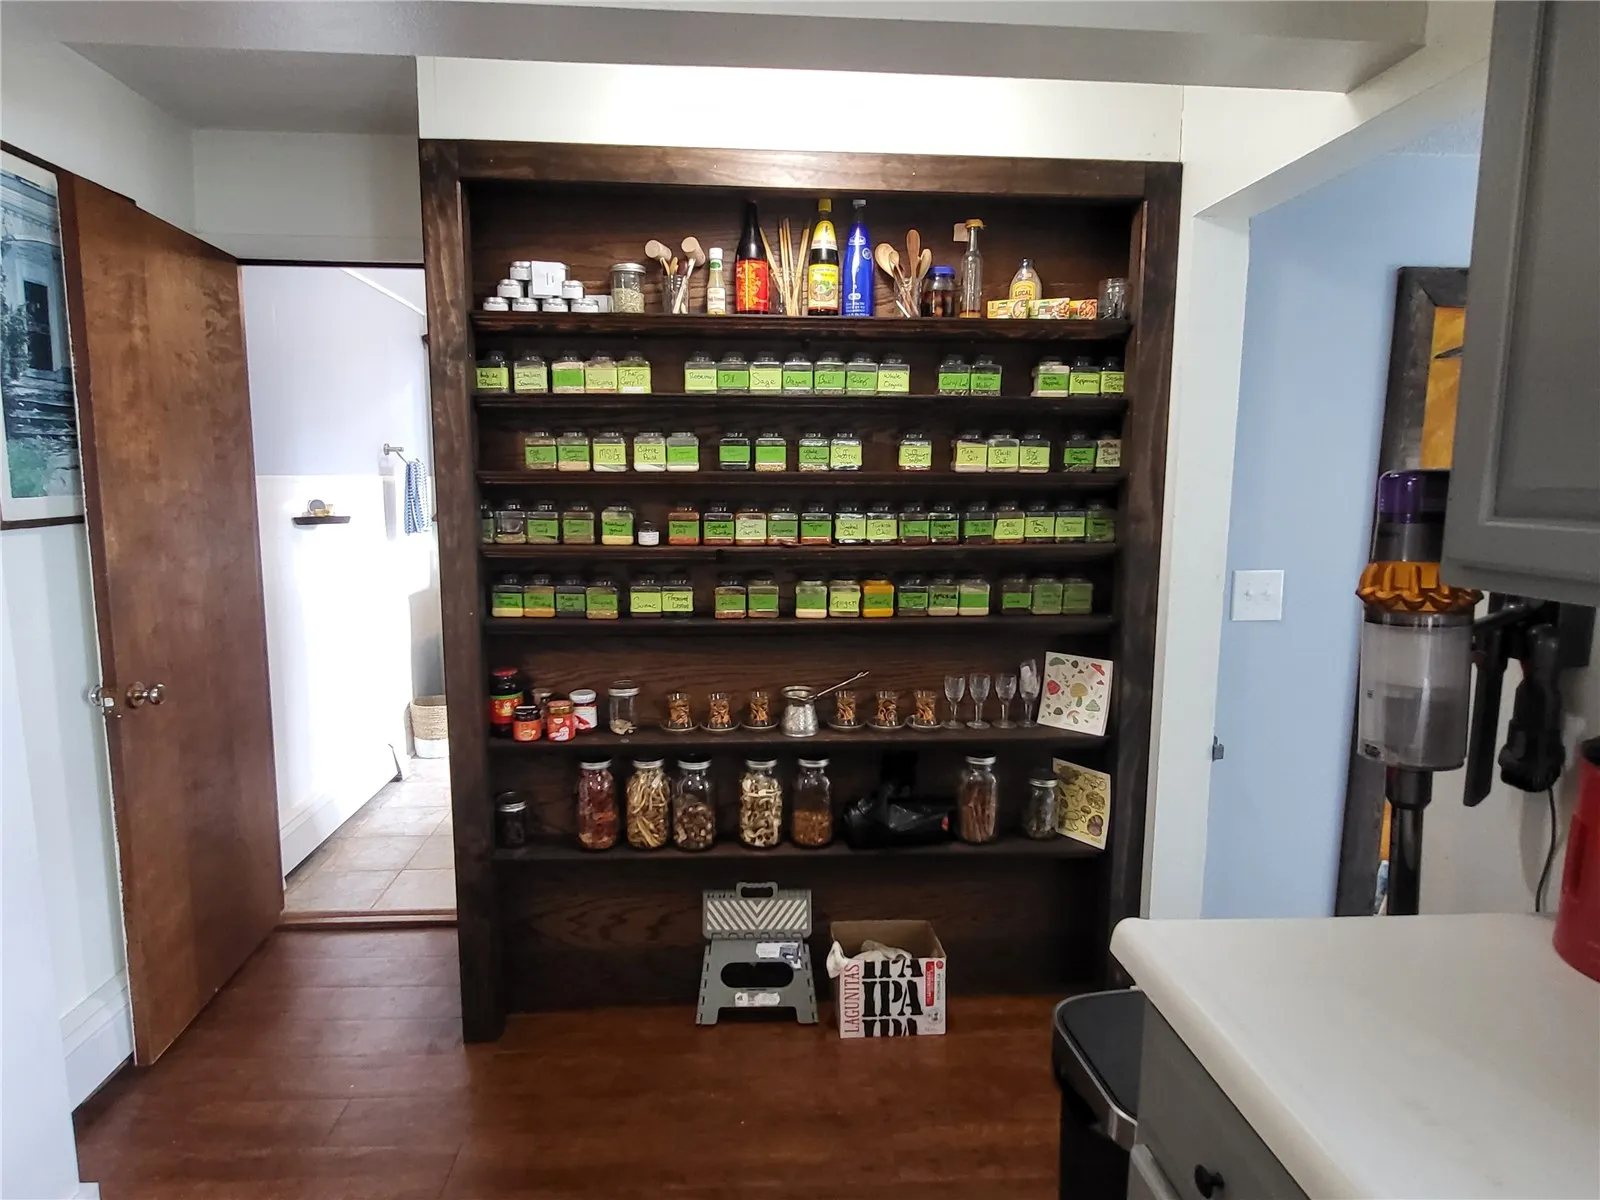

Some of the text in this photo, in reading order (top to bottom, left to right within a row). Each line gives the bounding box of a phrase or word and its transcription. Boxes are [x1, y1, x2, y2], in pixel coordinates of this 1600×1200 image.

[752, 372, 776, 388] Sage
[599, 447, 621, 461] MSG
[844, 963, 860, 1033] LAGUNITAS
[862, 980, 923, 1017] IPA
